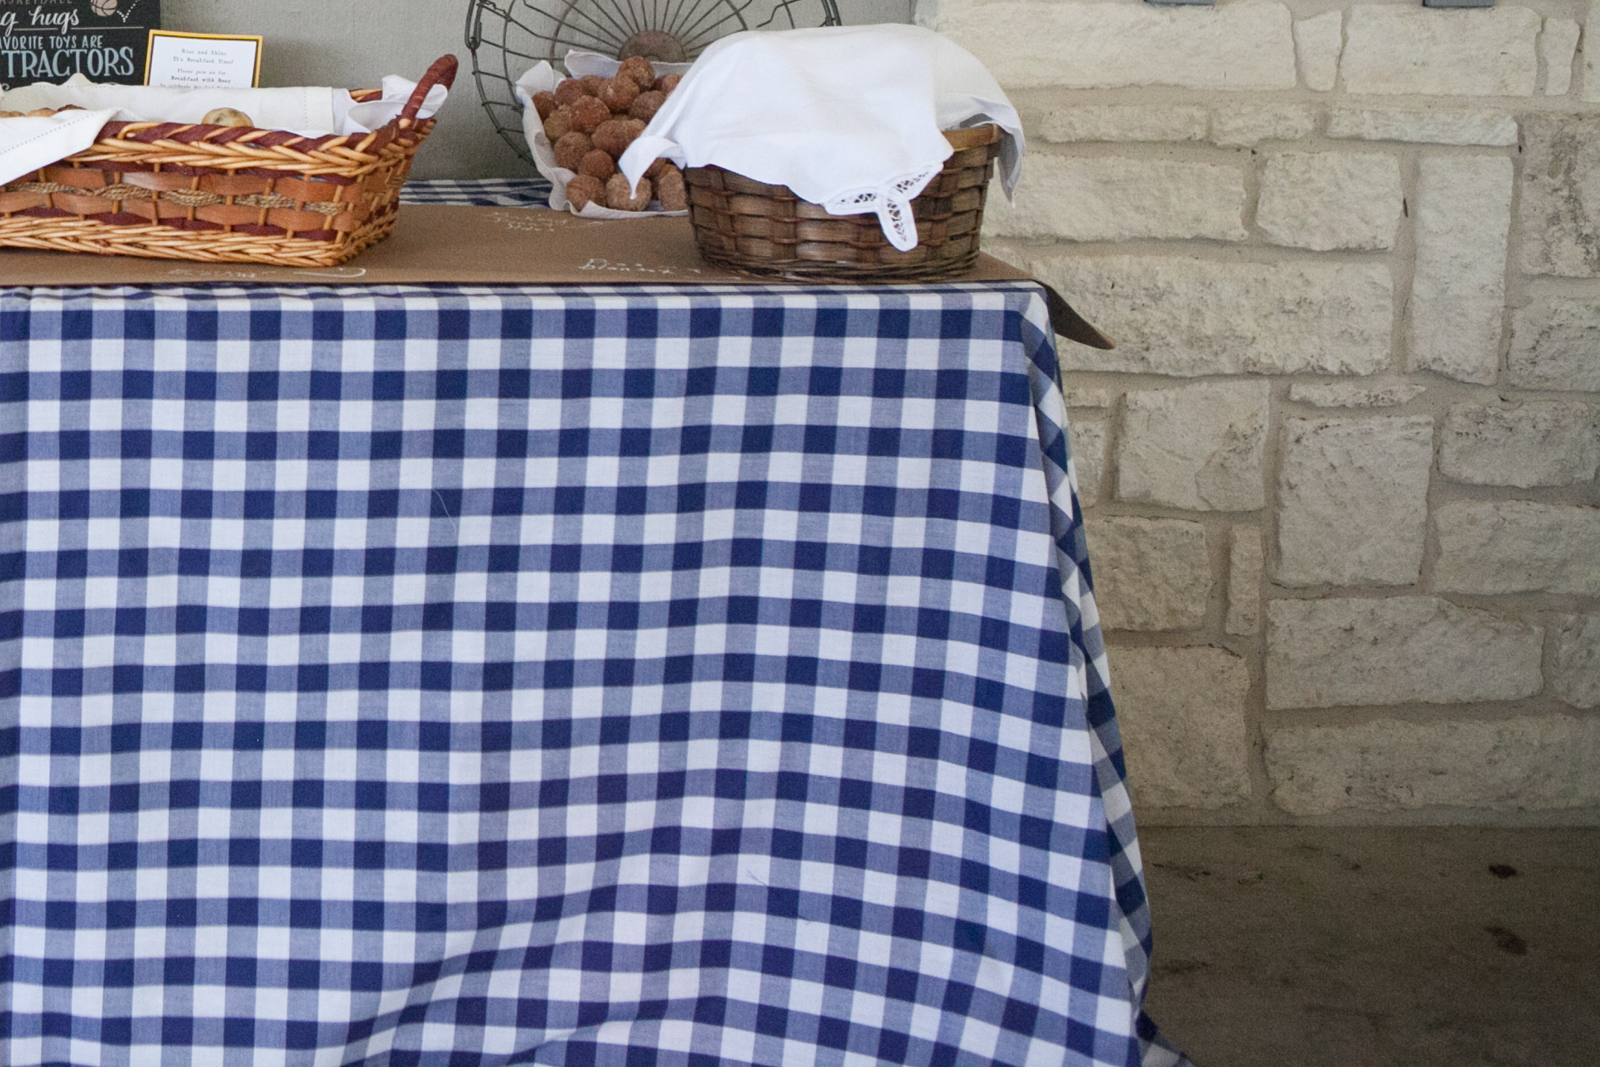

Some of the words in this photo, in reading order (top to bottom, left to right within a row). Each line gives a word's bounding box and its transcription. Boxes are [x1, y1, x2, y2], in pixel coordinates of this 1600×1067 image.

[29, 6, 79, 34] hugs
[49, 36, 77, 49] TOYS
[82, 35, 103, 48] ARE
[1, 46, 135, 78] TRACTORS
